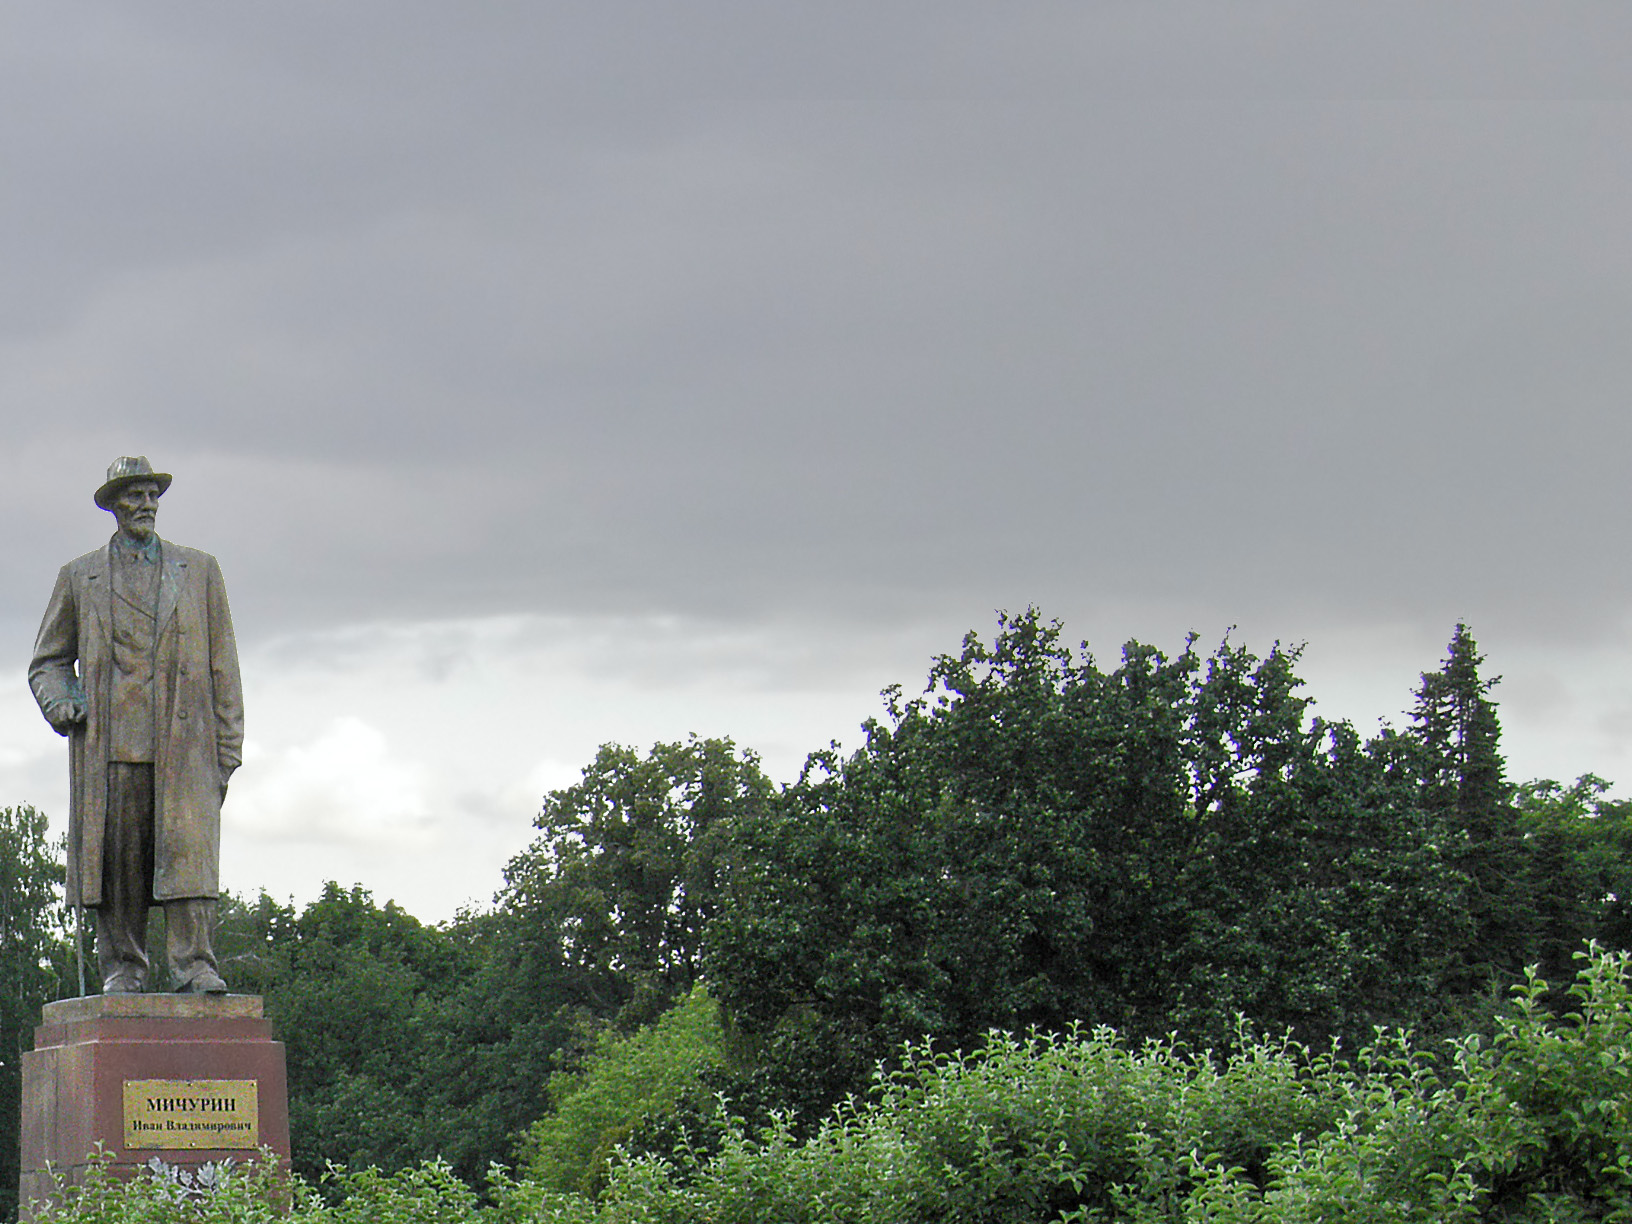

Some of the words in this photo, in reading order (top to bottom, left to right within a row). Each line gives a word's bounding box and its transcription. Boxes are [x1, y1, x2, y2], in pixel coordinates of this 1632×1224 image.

[146, 1098, 236, 1112] МИЧУРИН
[133, 1120, 163, 1131] Иван
[166, 1120, 251, 1133] Владимирович
